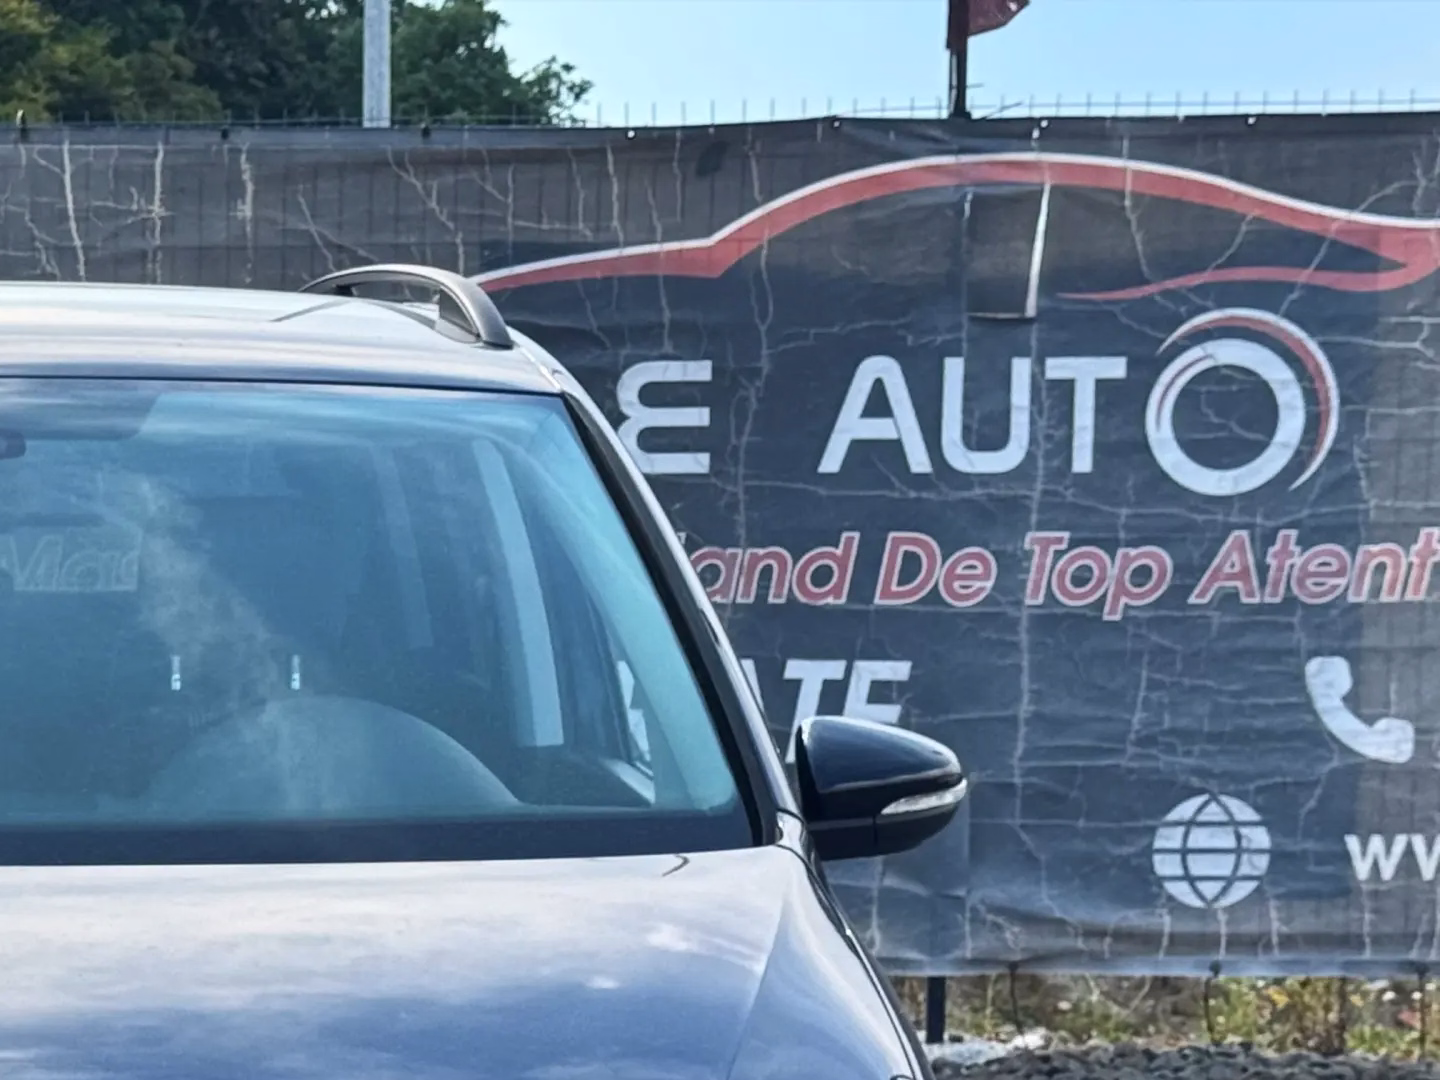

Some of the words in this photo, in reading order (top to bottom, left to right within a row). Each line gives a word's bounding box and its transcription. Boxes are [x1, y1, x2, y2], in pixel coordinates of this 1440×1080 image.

[817, 338, 1307, 497] AUTO
[874, 531, 997, 607] De
[1024, 531, 1173, 621] Top
